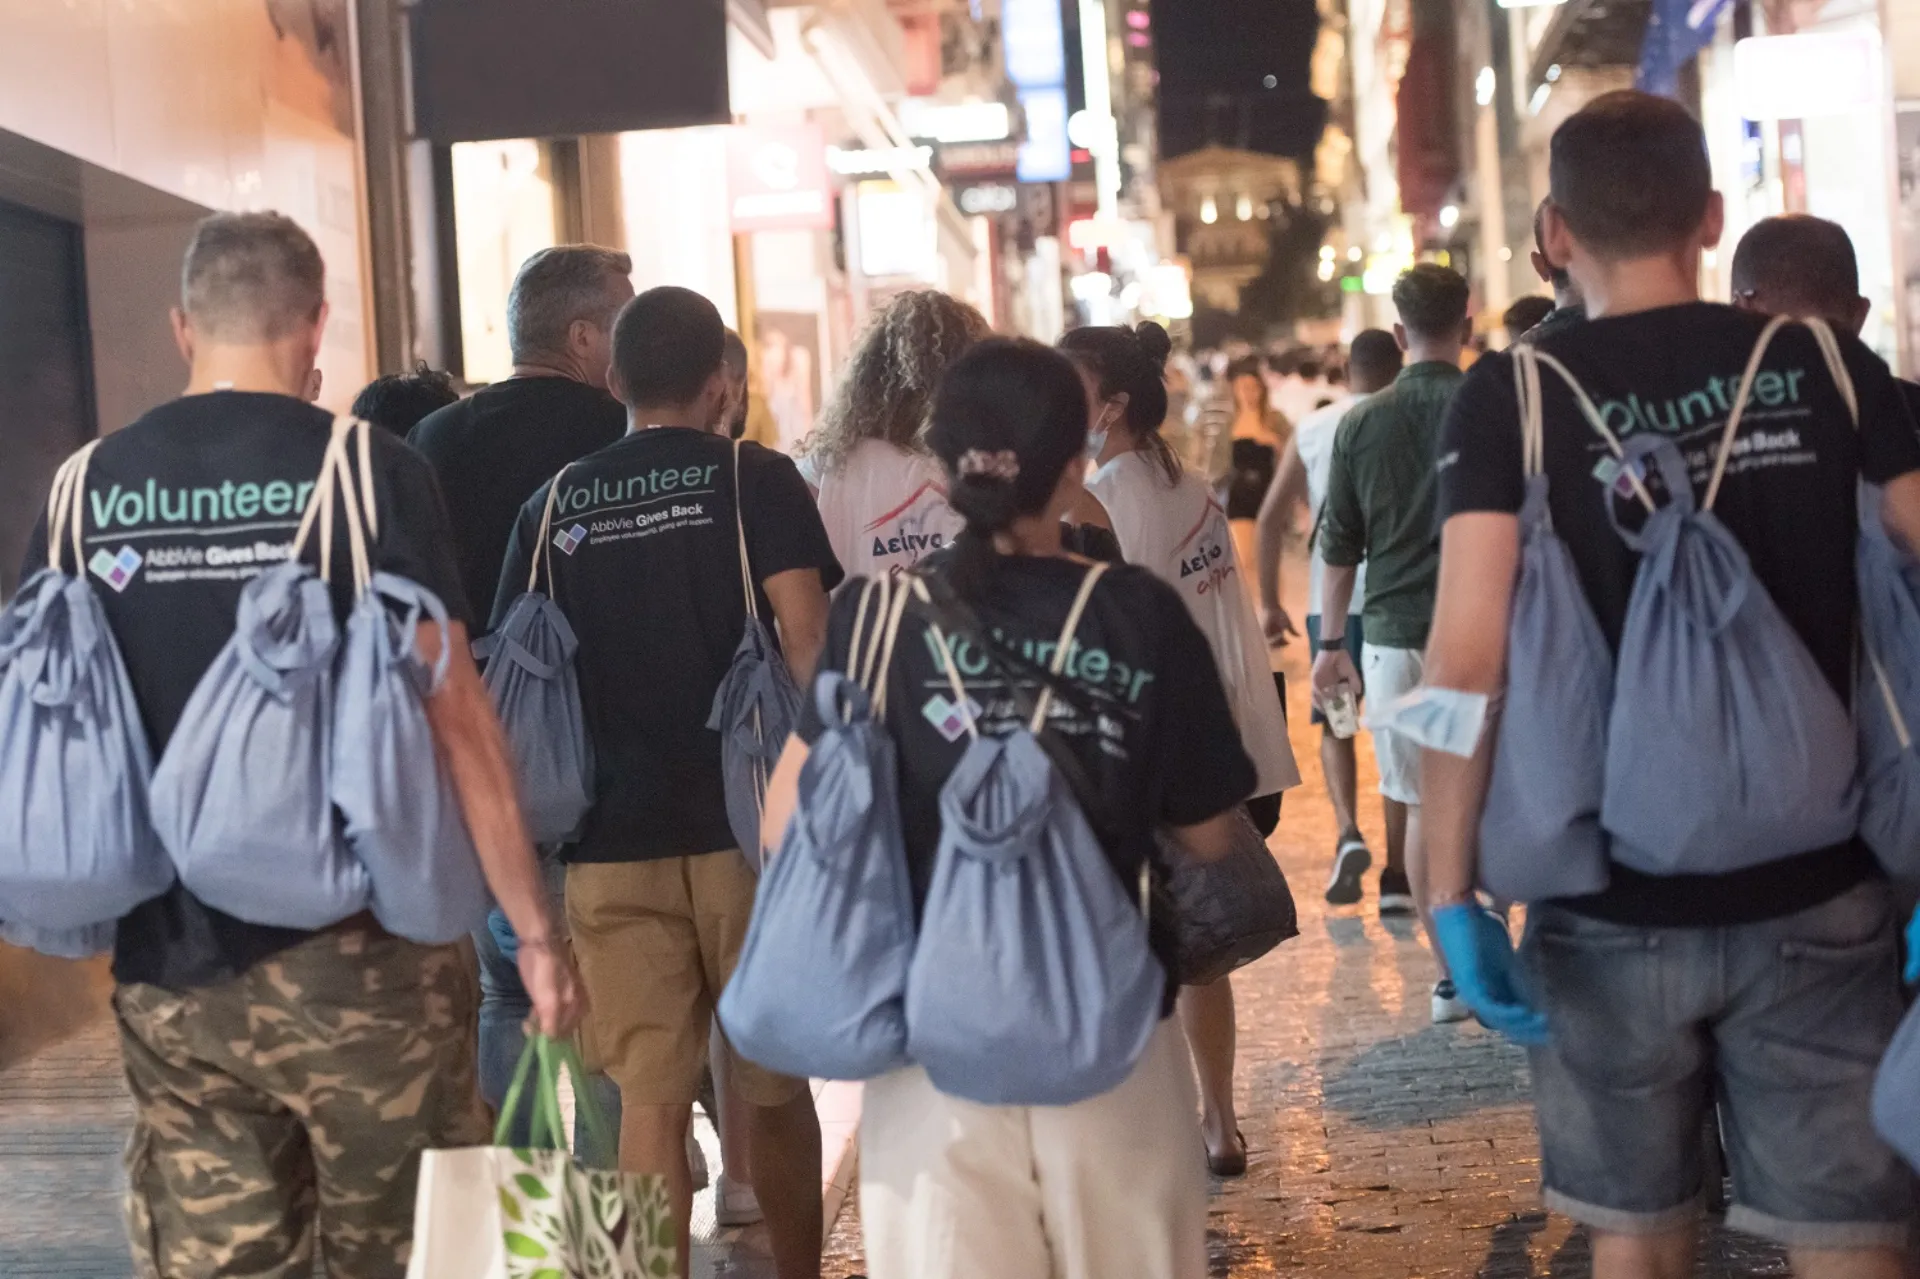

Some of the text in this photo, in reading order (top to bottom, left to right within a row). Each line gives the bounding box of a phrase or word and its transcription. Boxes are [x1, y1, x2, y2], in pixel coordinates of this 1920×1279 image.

[90, 478, 315, 529] Volunteer
[554, 464, 719, 515] Volunteer
[589, 503, 704, 534] AbbVie Gives Back
[205, 545, 254, 566] Gives
